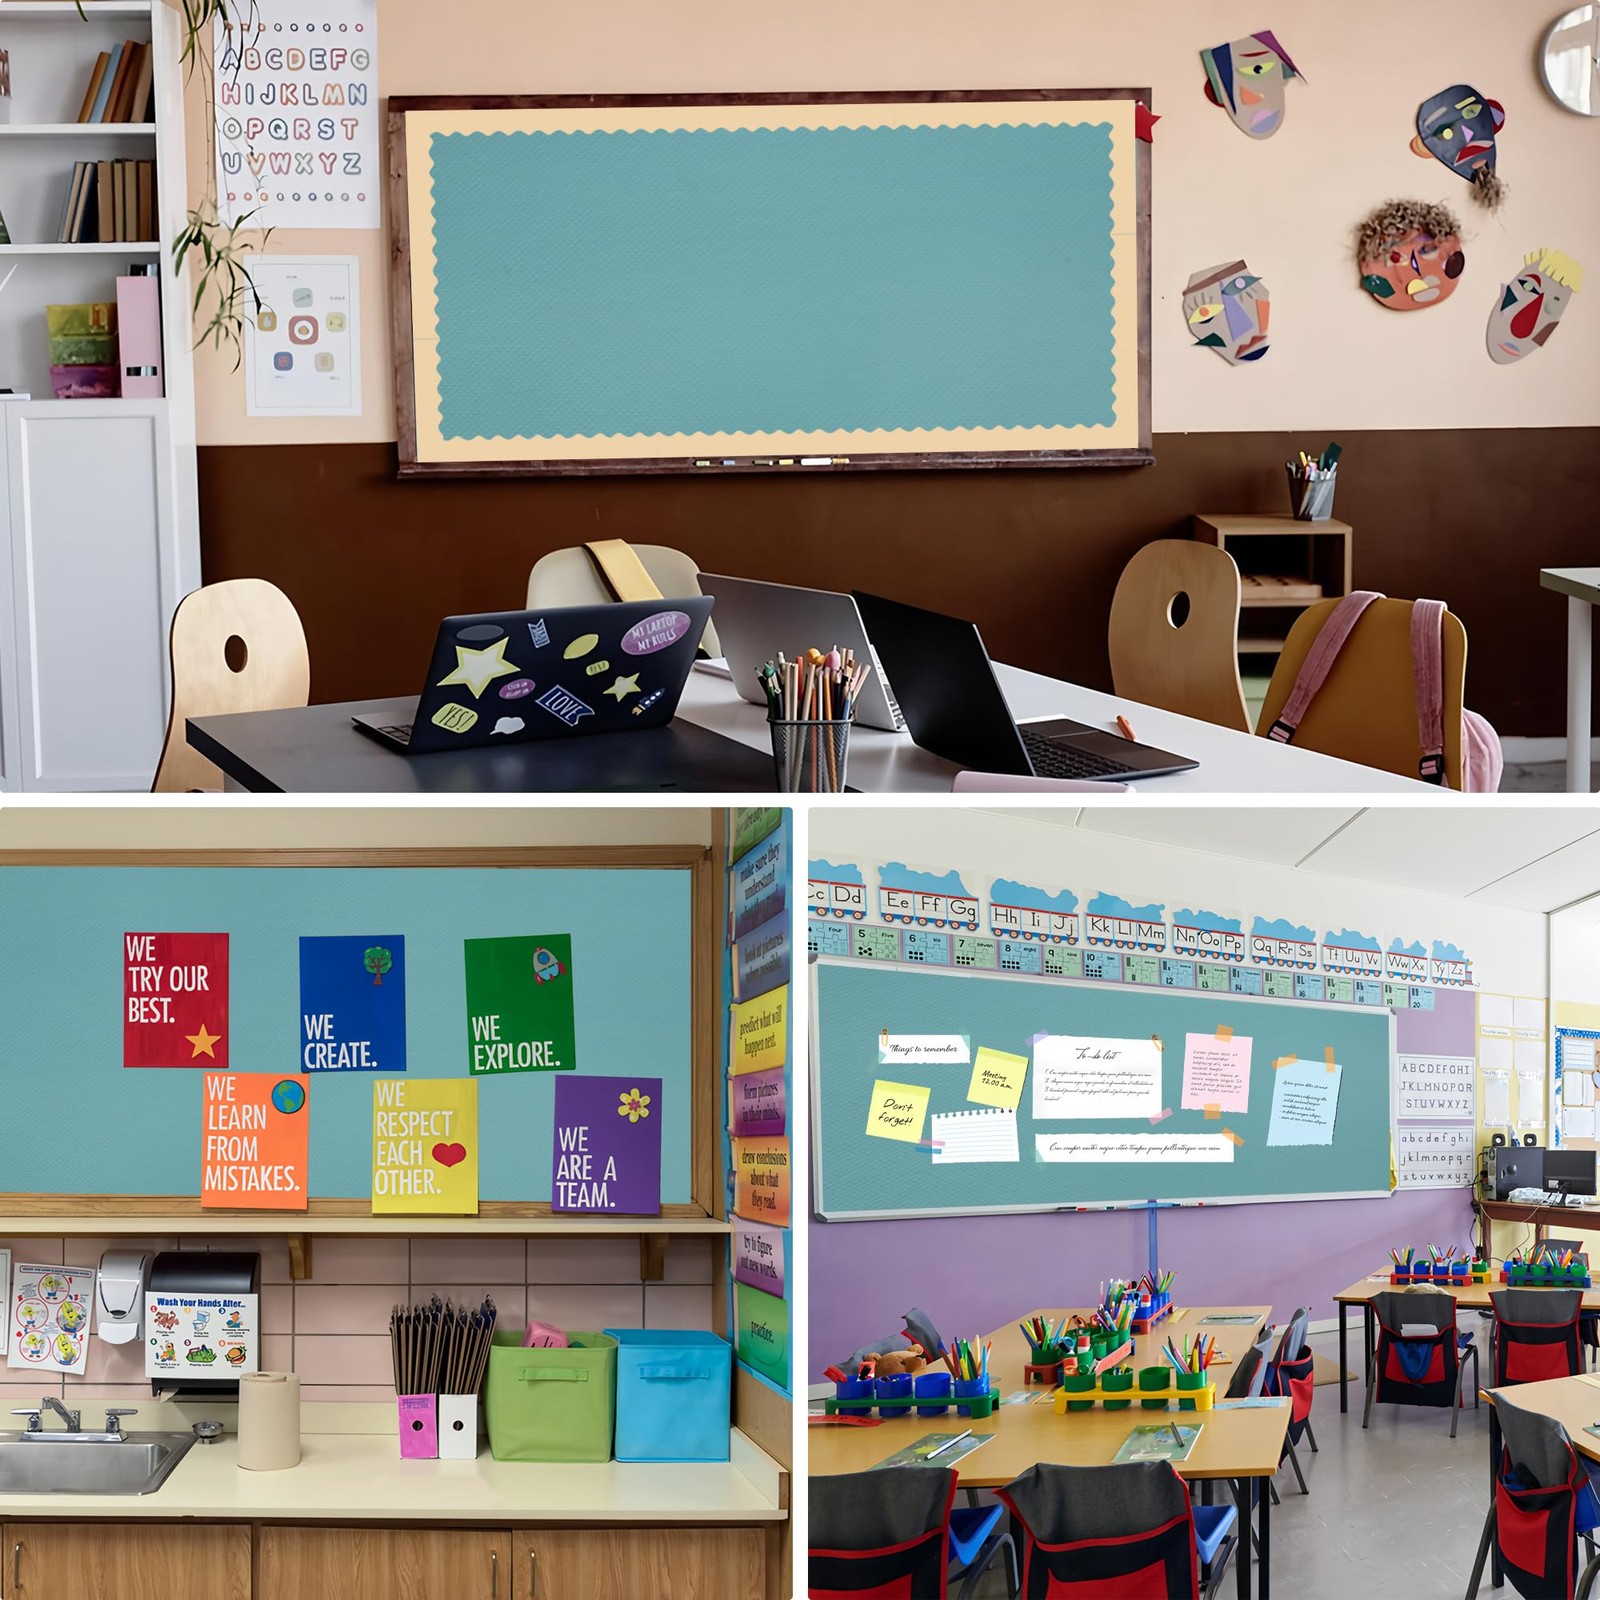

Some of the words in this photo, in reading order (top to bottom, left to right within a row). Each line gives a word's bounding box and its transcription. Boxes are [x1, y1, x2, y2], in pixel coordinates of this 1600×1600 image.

[439, 706, 470, 731] YES!
[545, 691, 583, 721] LOVE
[834, 886, 862, 905] Dd
[887, 891, 909, 909] Ee
[921, 895, 941, 912] Ff
[950, 899, 976, 923] Gg
[994, 907, 1017, 924] Hh
[1054, 915, 1073, 937] Jj
[1091, 917, 1110, 933] Kk
[1118, 920, 1132, 935] Ll
[1138, 923, 1164, 939] Mm
[1176, 928, 1195, 943] Nn
[1200, 931, 1220, 946] Oo
[1225, 935, 1241, 954] Pp
[1253, 938, 1274, 958] Qq
[1278, 941, 1293, 954] Rr
[1299, 944, 1312, 958] Ss
[1327, 947, 1338, 960] Tt
[1345, 950, 1360, 963] Uu
[1366, 953, 1378, 965] Vv
[1388, 955, 1409, 969] Ww
[1412, 958, 1425, 971] Xx
[1434, 962, 1445, 976] Yy
[1451, 963, 1463, 975] Zz
[858, 929, 866, 938] 5
[909, 934, 916, 942] 6
[958, 939, 965, 948] 7
[126, 935, 156, 962] WE
[1004, 944, 1011, 952] 8
[1048, 949, 1055, 957] 9
[1086, 953, 1095, 961] 10
[128, 966, 163, 993] TRY
[169, 965, 209, 992] OUR
[1166, 977, 1173, 985] 12
[128, 997, 175, 1024] BEST.
[304, 1014, 334, 1041] WE
[471, 1015, 501, 1042] WE
[304, 1041, 377, 1070] CREATE.
[474, 1041, 561, 1071] EXPLORE.
[890, 1044, 913, 1056] Things
[923, 1044, 958, 1052] remember
[207, 1076, 236, 1102] WE
[981, 1070, 1007, 1082] Meeting
[376, 1081, 405, 1107] WE
[208, 1104, 267, 1131] LEARN
[377, 1110, 453, 1137] RESPECT
[206, 1136, 258, 1162] FROM
[558, 1126, 589, 1152] WE
[377, 1140, 423, 1167] EACH
[204, 1165, 300, 1192] MISTAKES.
[556, 1154, 592, 1181] ARE
[603, 1156, 617, 1182] A
[375, 1168, 442, 1196] OTHER.
[556, 1182, 616, 1208] TEAM.
[157, 1297, 178, 1306] Wash
[179, 1298, 197, 1307] Your
[198, 1299, 221, 1308] Hands
